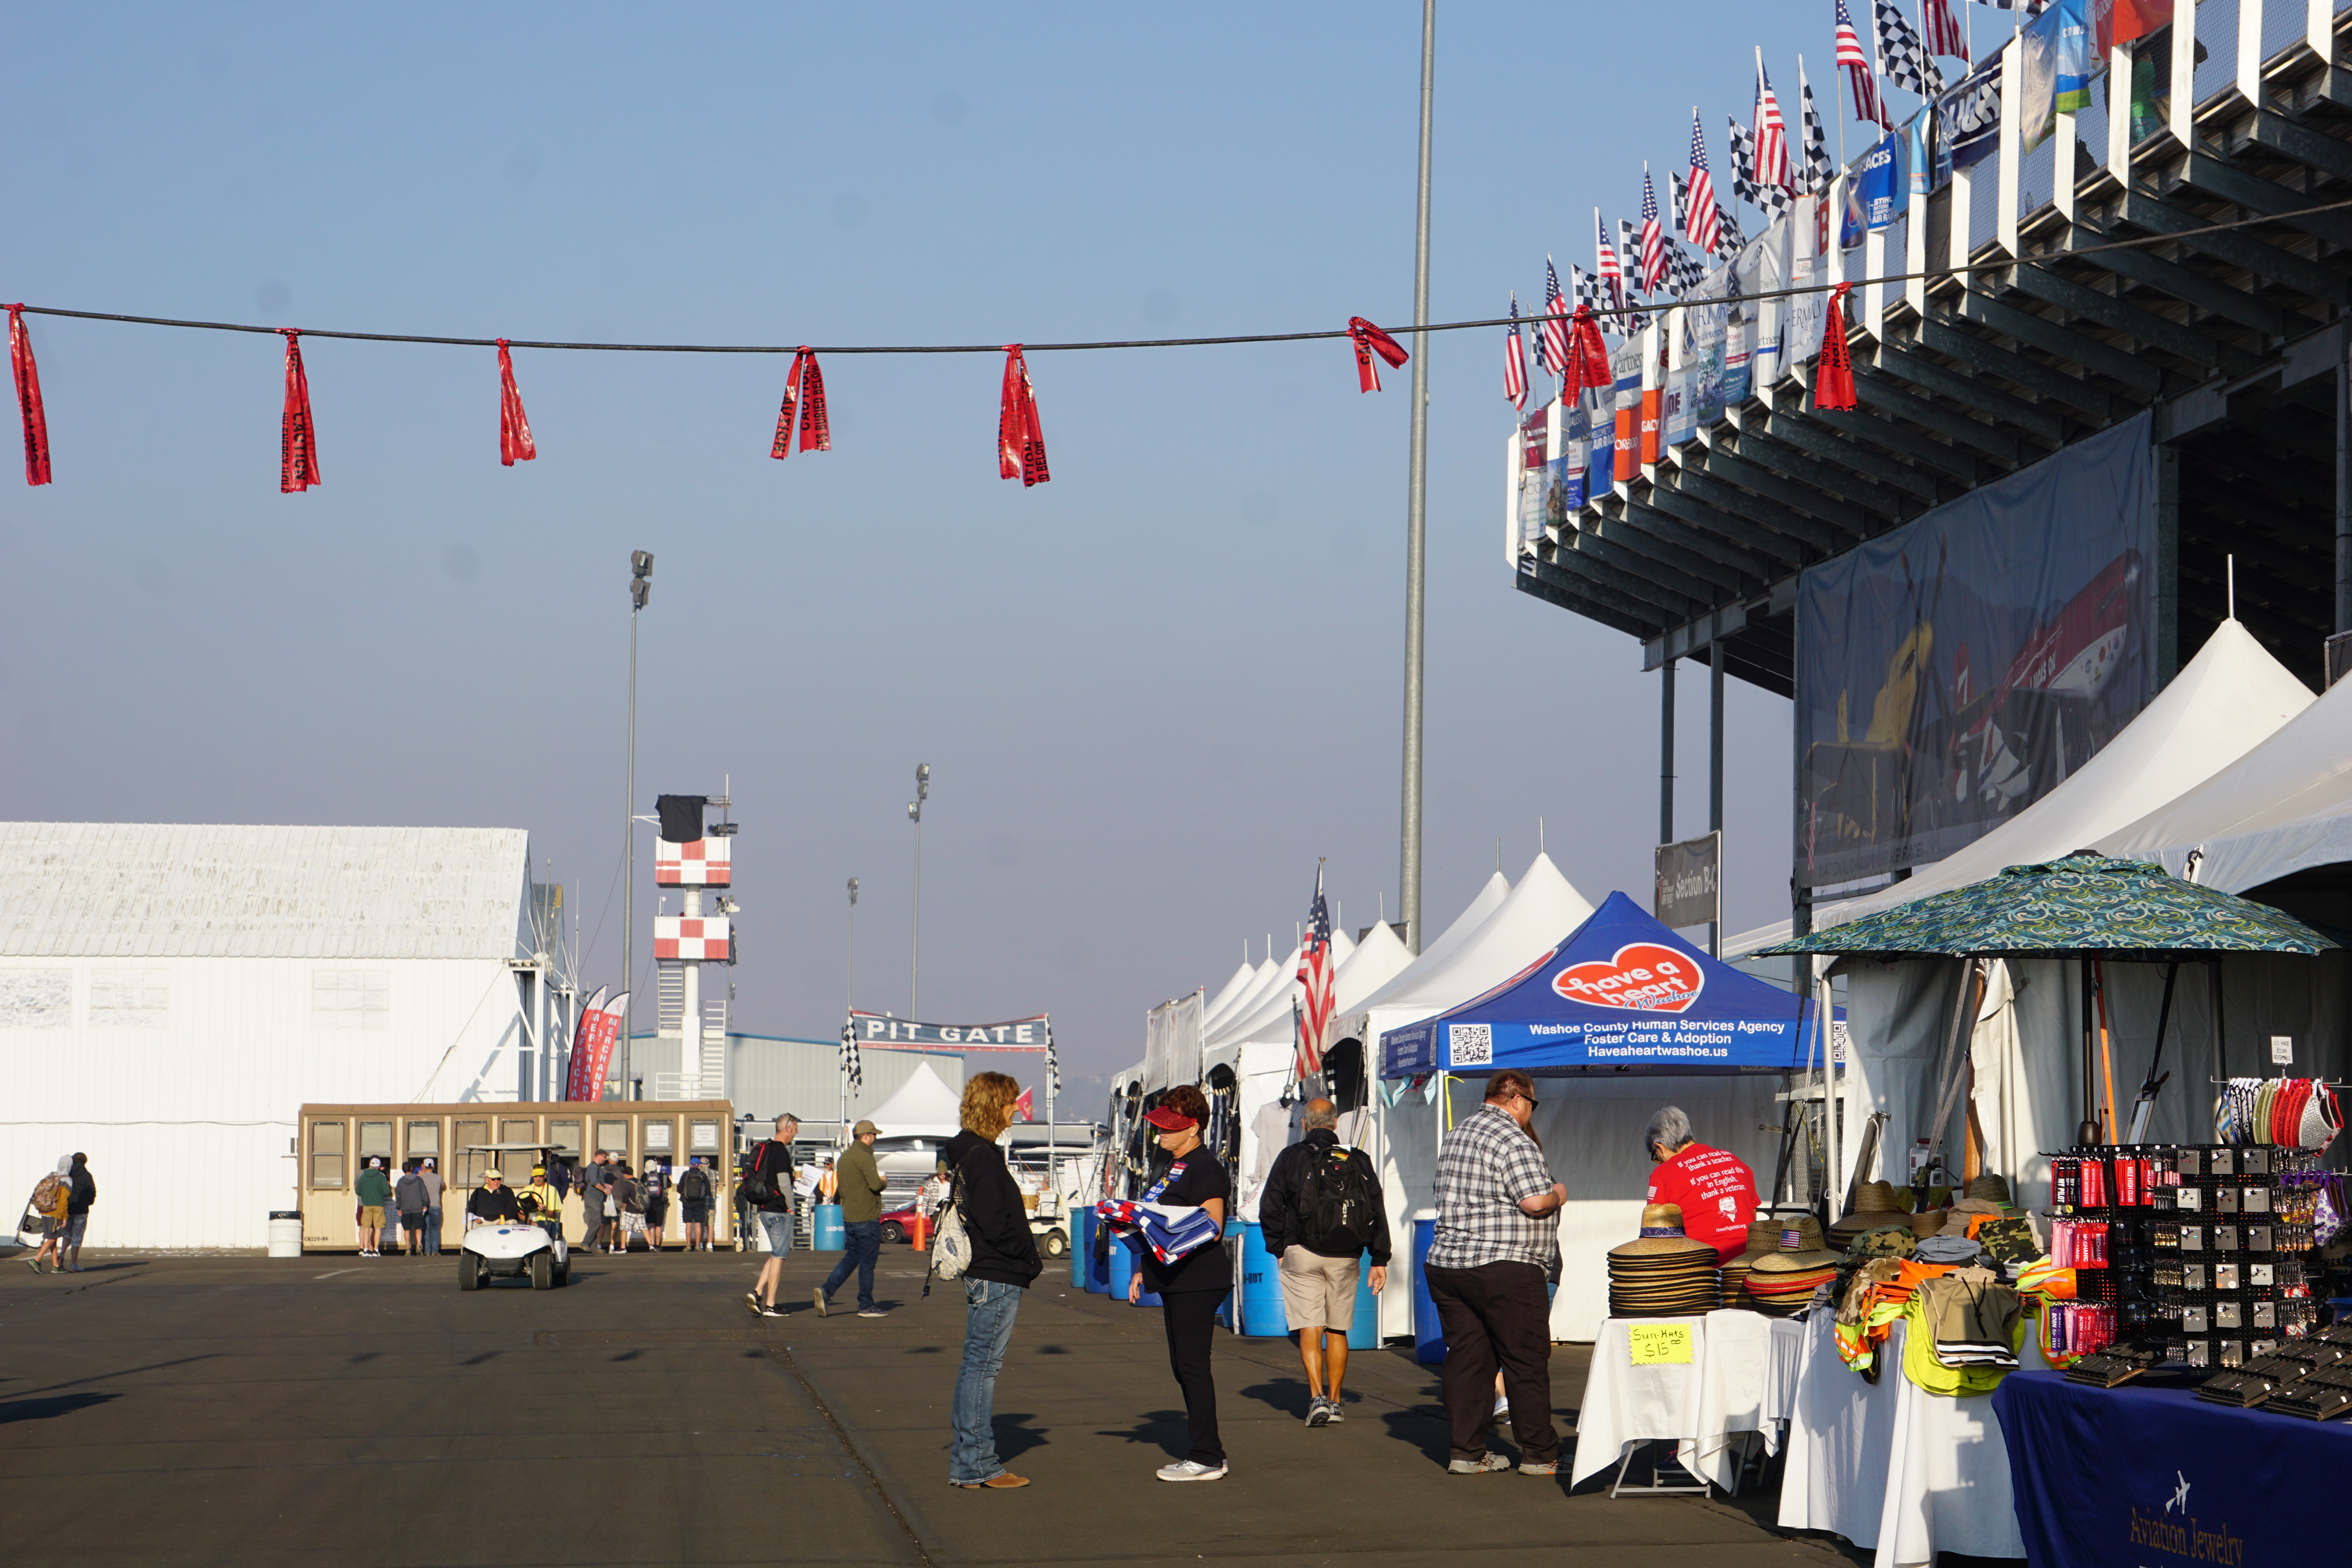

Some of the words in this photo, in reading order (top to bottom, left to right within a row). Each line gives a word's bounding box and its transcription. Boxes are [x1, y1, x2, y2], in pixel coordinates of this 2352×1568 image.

[1861, 148, 1892, 172] ACES
[811, 365, 824, 396] BELOW
[813, 397, 827, 431] BURIED
[293, 412, 306, 481] CAUTION
[1592, 437, 1603, 451] AIR
[1034, 441, 1047, 472] BELOW
[1676, 870, 1702, 900] Section
[1703, 864, 1716, 893] B-C
[1558, 968, 1653, 995] have
[1656, 961, 1681, 975] a
[1599, 976, 1688, 1004] heart
[1624, 990, 1699, 1010] Washoe
[867, 1020, 921, 1040] PIT
[940, 1024, 1033, 1043] GATE
[1529, 1024, 1581, 1035] Washoe
[1583, 1022, 1628, 1034] County
[1632, 1021, 1676, 1031] Human
[1680, 1019, 1735, 1032] Services
[1738, 1020, 1785, 1035] Agency
[1584, 1033, 1625, 1045] Foster
[1628, 1033, 1658, 1044] Care
[1662, 1034, 1671, 1043] &
[1674, 1034, 1732, 1046] Adoption
[591, 1017, 618, 1102] MERCHANDI
[1588, 1045, 1728, 1058] Haveaheartwashoe.us
[571, 1027, 587, 1102] OFFICIA
[1683, 1156, 1696, 1168] you
[1696, 1152, 1709, 1161] can
[1708, 1150, 1722, 1158] read
[1688, 1161, 1707, 1172] thank
[1712, 1155, 1735, 1165] teacher.
[1689, 1178, 1696, 1186] If
[1696, 1175, 1709, 1186] you
[1709, 1171, 1721, 1179] can
[1721, 1166, 1736, 1177] read
[1736, 1166, 1745, 1175] this
[1706, 1181, 1714, 1189] in
[1715, 1175, 1739, 1187] English,
[2057, 1178, 2065, 1187] MY
[1700, 1188, 1719, 1201] thank
[1725, 1183, 1747, 1193] veteran.
[2057, 1188, 2065, 1203] PILOT
[1716, 1223, 1747, 1233] HonorFlightNV.org
[2130, 1504, 2187, 1556] Aviation
[2190, 1517, 2243, 1568] Jewelry
